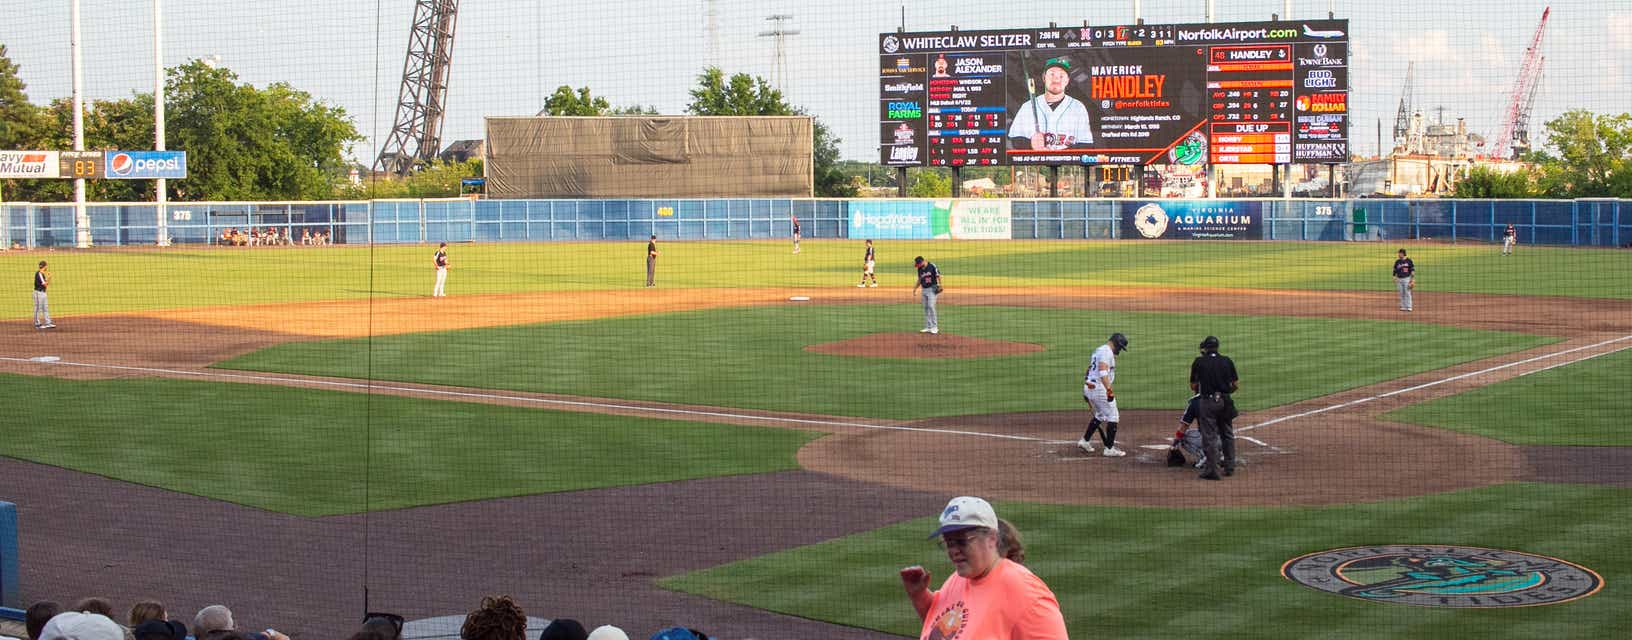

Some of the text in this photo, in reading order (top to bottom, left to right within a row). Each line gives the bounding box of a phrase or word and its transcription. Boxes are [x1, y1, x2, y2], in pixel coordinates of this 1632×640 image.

[1108, 30, 1115, 38] 3
[1138, 29, 1146, 37] 2
[1178, 27, 1297, 41] NorfolkAirport.com
[902, 34, 1031, 50] WHITECLAW SELTZER
[1230, 50, 1272, 60] HANDLEY
[955, 58, 983, 66] JASON
[955, 65, 1002, 73] ALEXANDER
[1091, 65, 1142, 75] MAVERICK
[1309, 70, 1332, 79] BUD
[885, 82, 924, 93] Smithfield
[1091, 74, 1166, 99] HANDLEY
[1304, 78, 1336, 88] LIGHT
[1312, 94, 1346, 103] FAMILY
[888, 102, 921, 110] ROYAL
[1312, 103, 1346, 112] DOLLAR
[888, 110, 921, 119] FARMS
[890, 146, 918, 160] Langley
[0, 163, 46, 173] Mutual
[75, 160, 95, 175] 83
[135, 156, 179, 172] pepsi
[173, 210, 190, 220] 375
[657, 207, 673, 216] 400
[968, 207, 981, 215] WE
[1315, 206, 1332, 216] 375
[991, 215, 1009, 224] FOR
[1175, 215, 1251, 225] AQUARIUM
[963, 225, 978, 233] THE
[1430, 586, 1577, 604] TIDES
